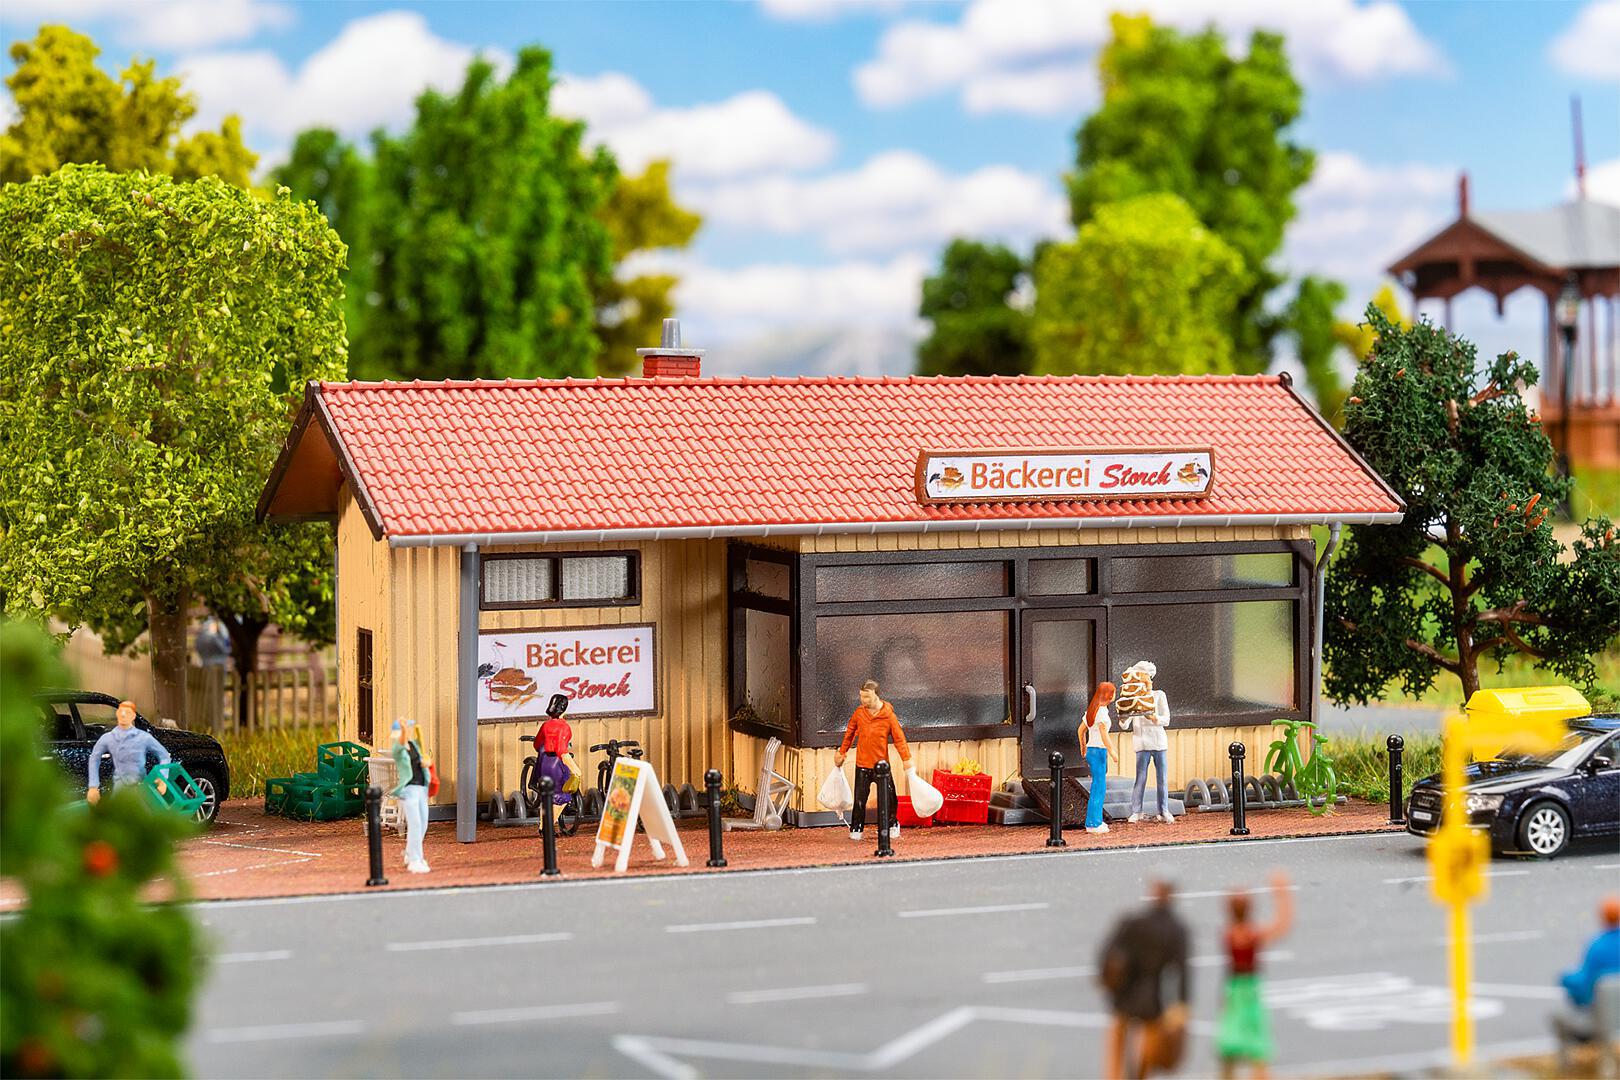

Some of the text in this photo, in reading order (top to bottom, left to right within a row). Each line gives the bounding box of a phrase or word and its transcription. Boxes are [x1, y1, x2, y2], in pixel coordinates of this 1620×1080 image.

[971, 460, 1173, 489] Bäckerei Storch
[526, 637, 641, 668] Bäckerei
[560, 672, 632, 701] Storch
